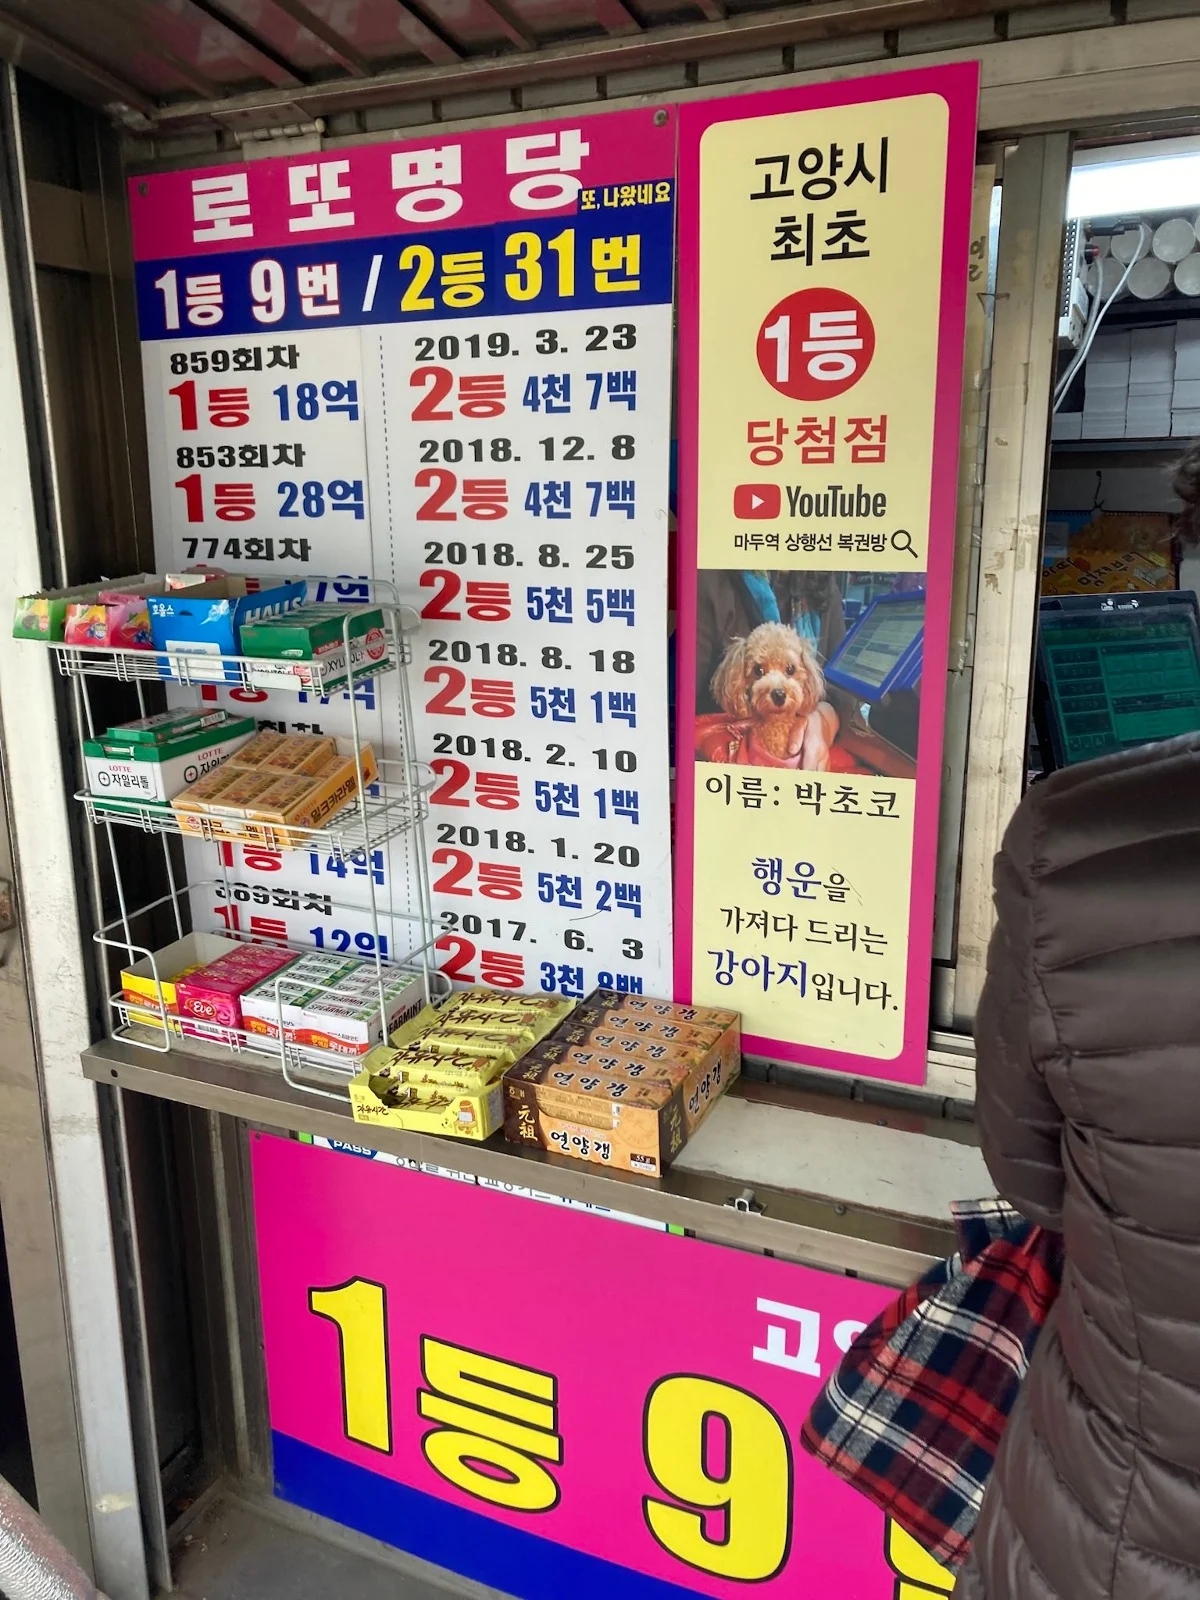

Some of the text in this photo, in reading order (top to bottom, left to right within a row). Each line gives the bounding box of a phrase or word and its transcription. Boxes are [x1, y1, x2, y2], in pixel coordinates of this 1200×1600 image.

[750, 136, 889, 201] 고양시
[771, 209, 870, 266] 최초
[155, 269, 224, 330] 1등
[399, 244, 486, 313] 2등
[169, 343, 300, 375] 859회차
[414, 323, 637, 362] 2019. 3. 23
[764, 309, 864, 383] 1등
[168, 380, 359, 431] 1등 18억
[409, 366, 636, 422] 2등 4천 7백
[176, 444, 305, 469] 853회차
[419, 435, 635, 463] 2018. 12. 8
[747, 415, 887, 466] 당첨점
[175, 473, 365, 523] 1등 28억
[414, 468, 635, 522] 2등 4천 7백
[786, 485, 886, 518] YouTube
[182, 538, 311, 562] 774회차
[424, 541, 635, 569] 2018. 8. 25
[734, 532, 887, 553] 마두역 상행선 복권방
[152, 603, 175, 617] 호올스
[419, 568, 635, 627] 2등 5천 5백
[428, 639, 635, 674] 2018. 8. 18
[424, 665, 636, 728] 2등 5천 1백
[108, 765, 132, 773] LOTTE
[433, 733, 637, 773] 2018. 2. 10
[112, 773, 149, 789] 자일리톨
[429, 758, 639, 825] 2등 5천 1백
[705, 773, 900, 819] 이름: 박초코
[437, 823, 640, 868] 2018. 1. 20
[432, 848, 641, 919] 2등 5천 2백
[752, 857, 851, 903] 행운을
[440, 911, 643, 960] 2017. 6. 3
[720, 906, 888, 956] 가져다 드리는
[435, 935, 525, 988] 2등
[540, 961, 584, 999] 3천
[708, 949, 898, 1011] 강아지입니다.
[193, 1001, 213, 1015] Eve
[610, 1016, 680, 1038] 연양갱
[630, 1000, 698, 1021] 연양갱
[573, 1052, 646, 1077] 연양갱
[595, 1034, 667, 1058] 연양갱
[553, 1072, 629, 1097] 연양갱
[688, 1058, 721, 1115] 연양갱
[518, 1104, 538, 1142] 元祖
[551, 1131, 610, 1160] 연양갱
[308, 1275, 563, 1514] 1등
